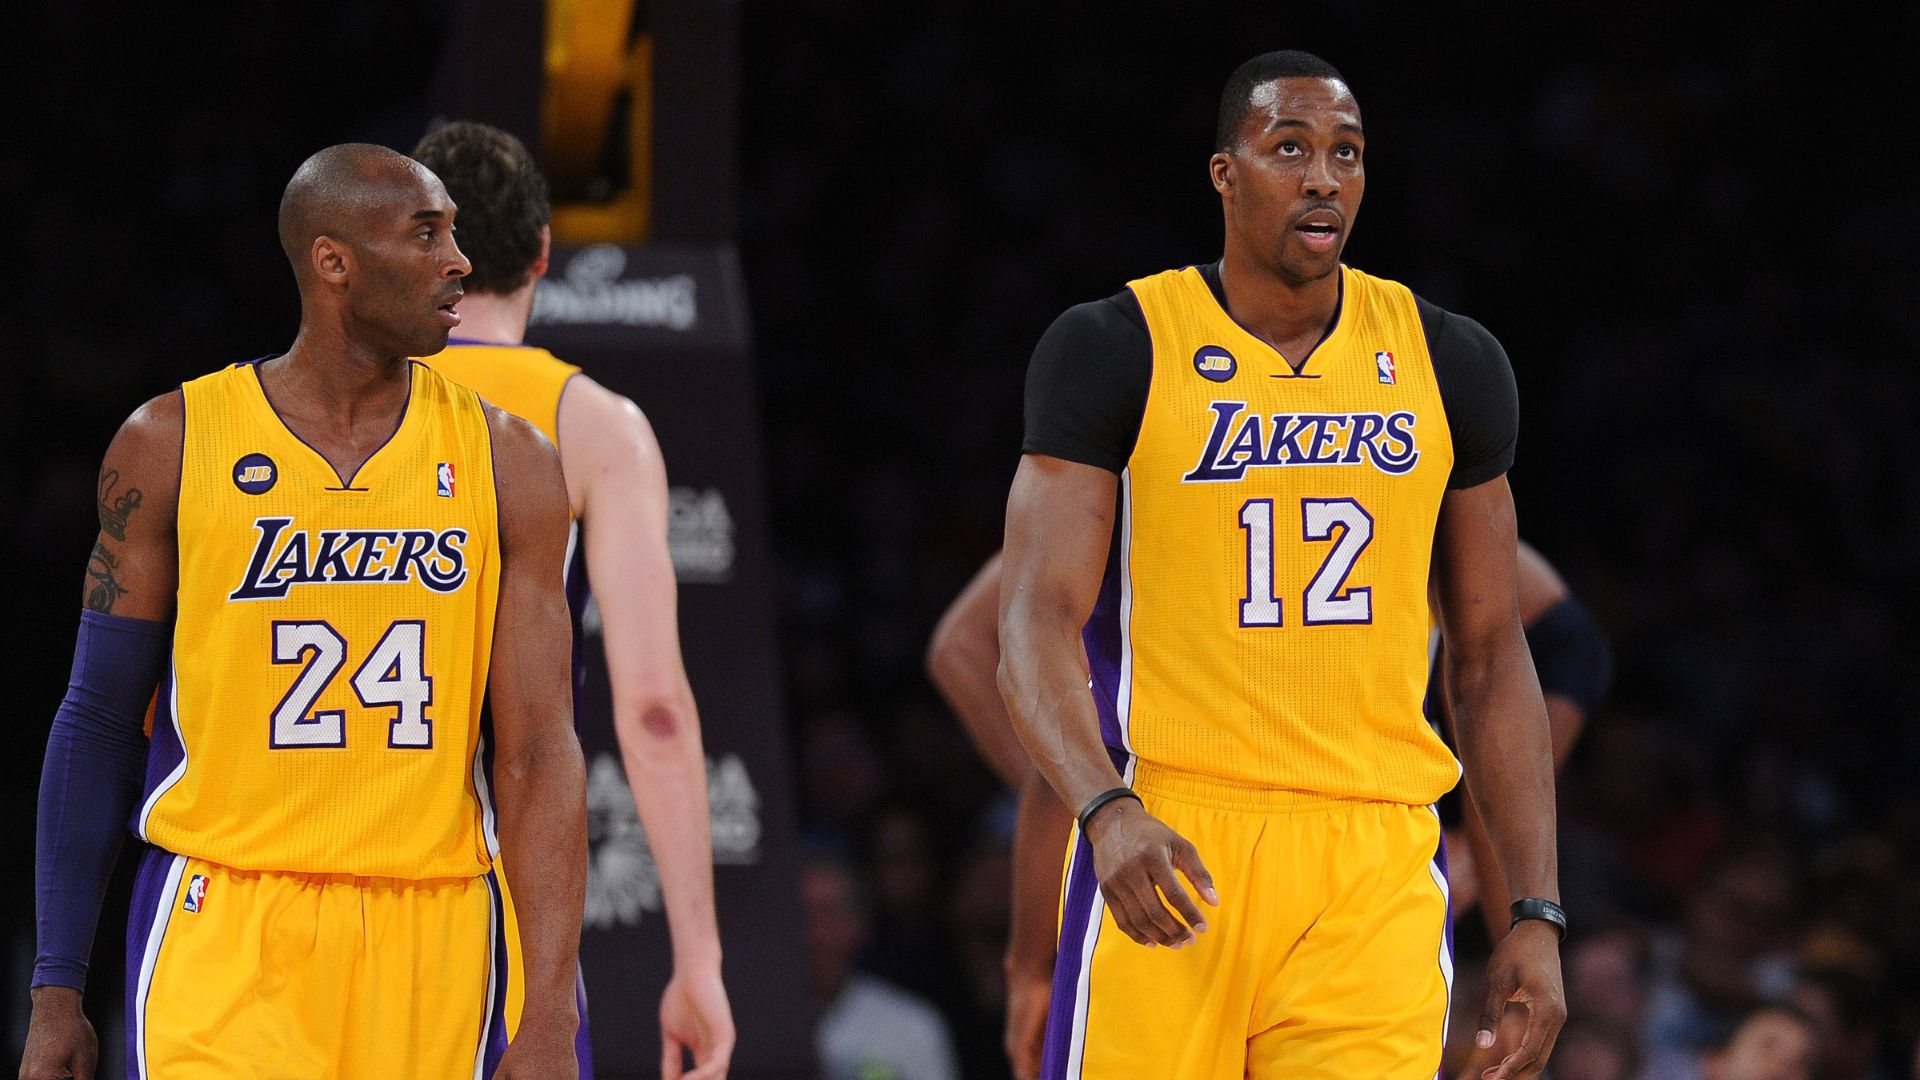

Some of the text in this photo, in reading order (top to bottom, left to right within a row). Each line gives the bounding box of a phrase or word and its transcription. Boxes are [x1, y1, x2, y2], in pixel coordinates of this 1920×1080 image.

[1198, 355, 1231, 371] JB
[238, 465, 272, 483] JB
[1181, 400, 1420, 485] LAKERS
[228, 516, 469, 603] LAKERS
[1238, 497, 1374, 628] 12
[269, 620, 433, 750] 24
